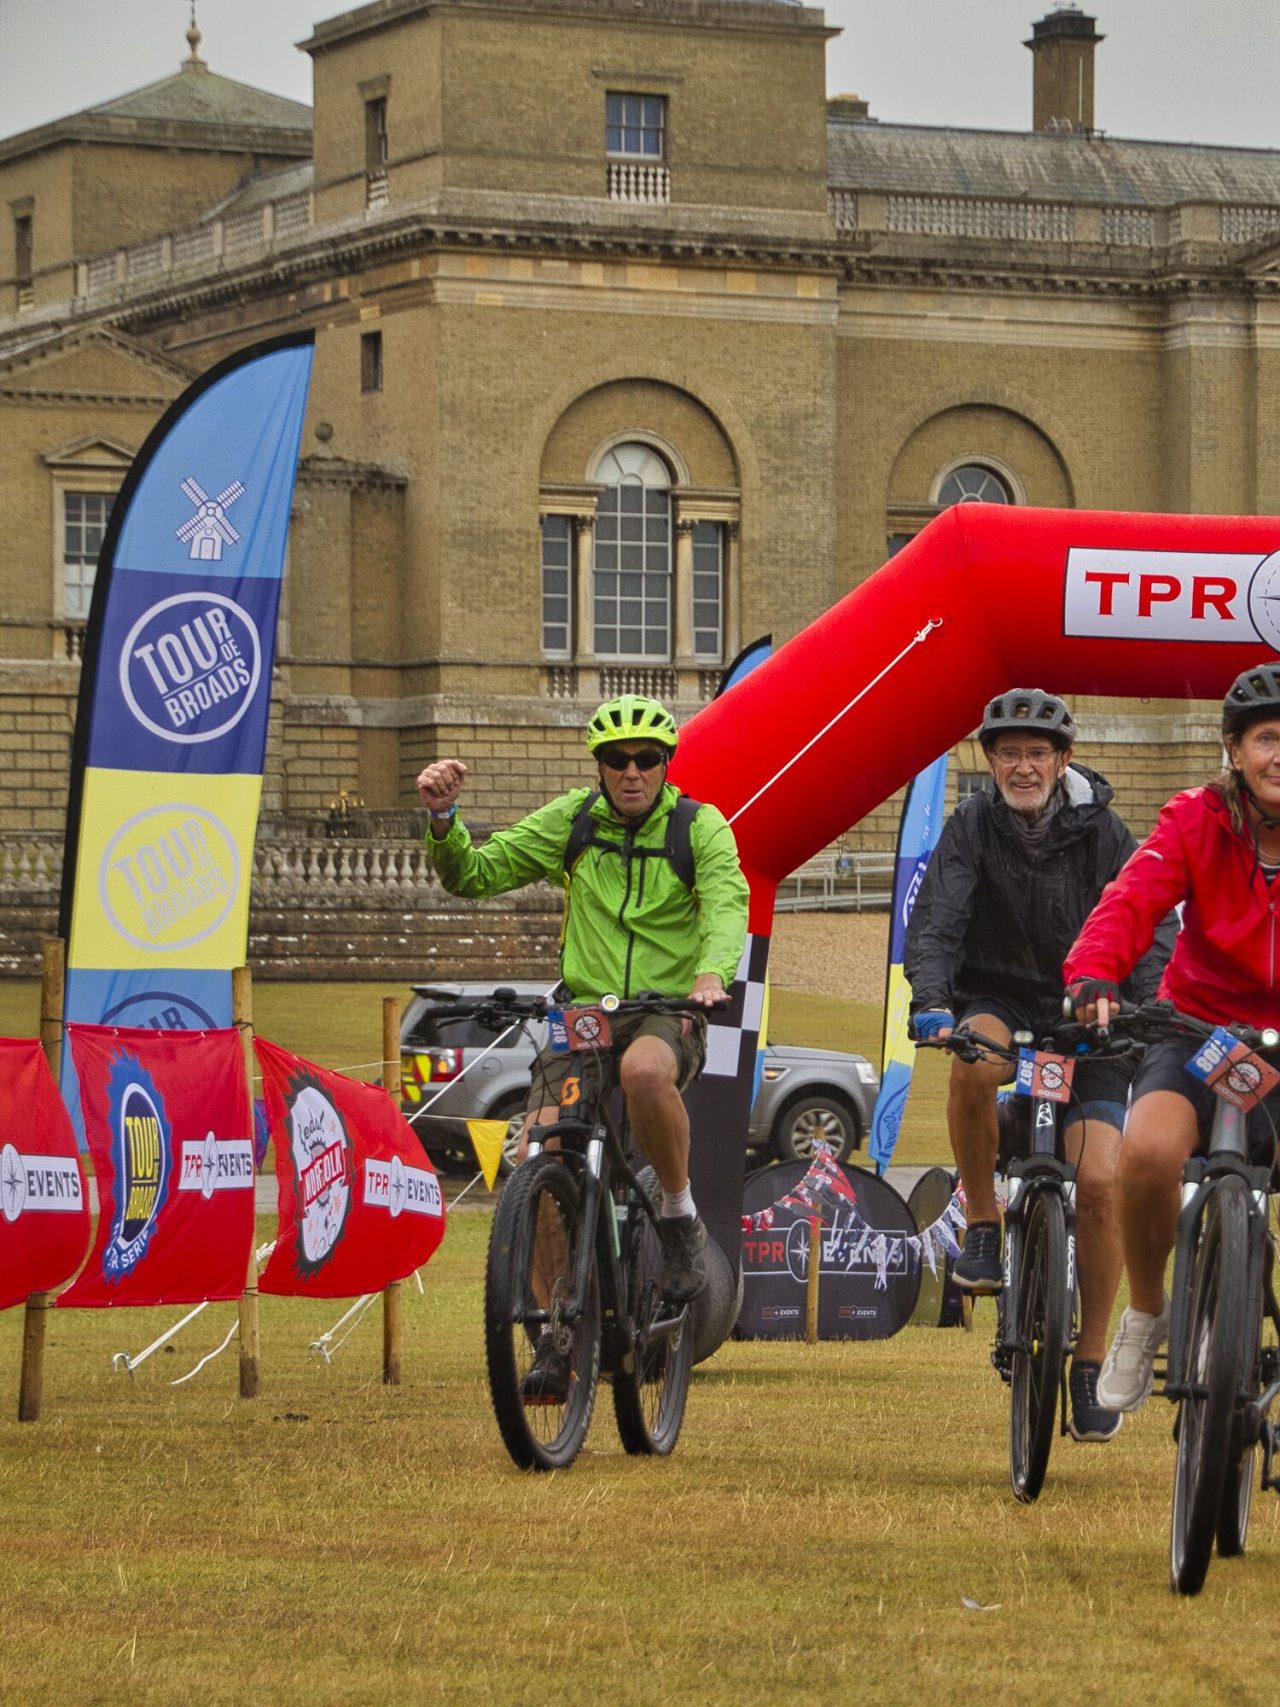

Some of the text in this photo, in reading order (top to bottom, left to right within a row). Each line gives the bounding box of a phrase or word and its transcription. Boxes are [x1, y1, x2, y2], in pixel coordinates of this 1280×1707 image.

[1085, 572, 1237, 620] TPR
[134, 608, 232, 695] TOUR
[221, 639, 241, 662] DE
[164, 658, 251, 728] BROADS
[113, 818, 207, 906] TOUR
[142, 866, 228, 936] BROADS
[1020, 1060, 1034, 1087] 307
[125, 1117, 159, 1178] TOUR
[218, 1153, 252, 1178] EVENTS
[27, 1170, 80, 1198] EVENTS
[304, 1146, 343, 1201] NORFOLK
[368, 1172, 441, 1206] TPR EVENTS
[745, 1241, 784, 1263] TPR
